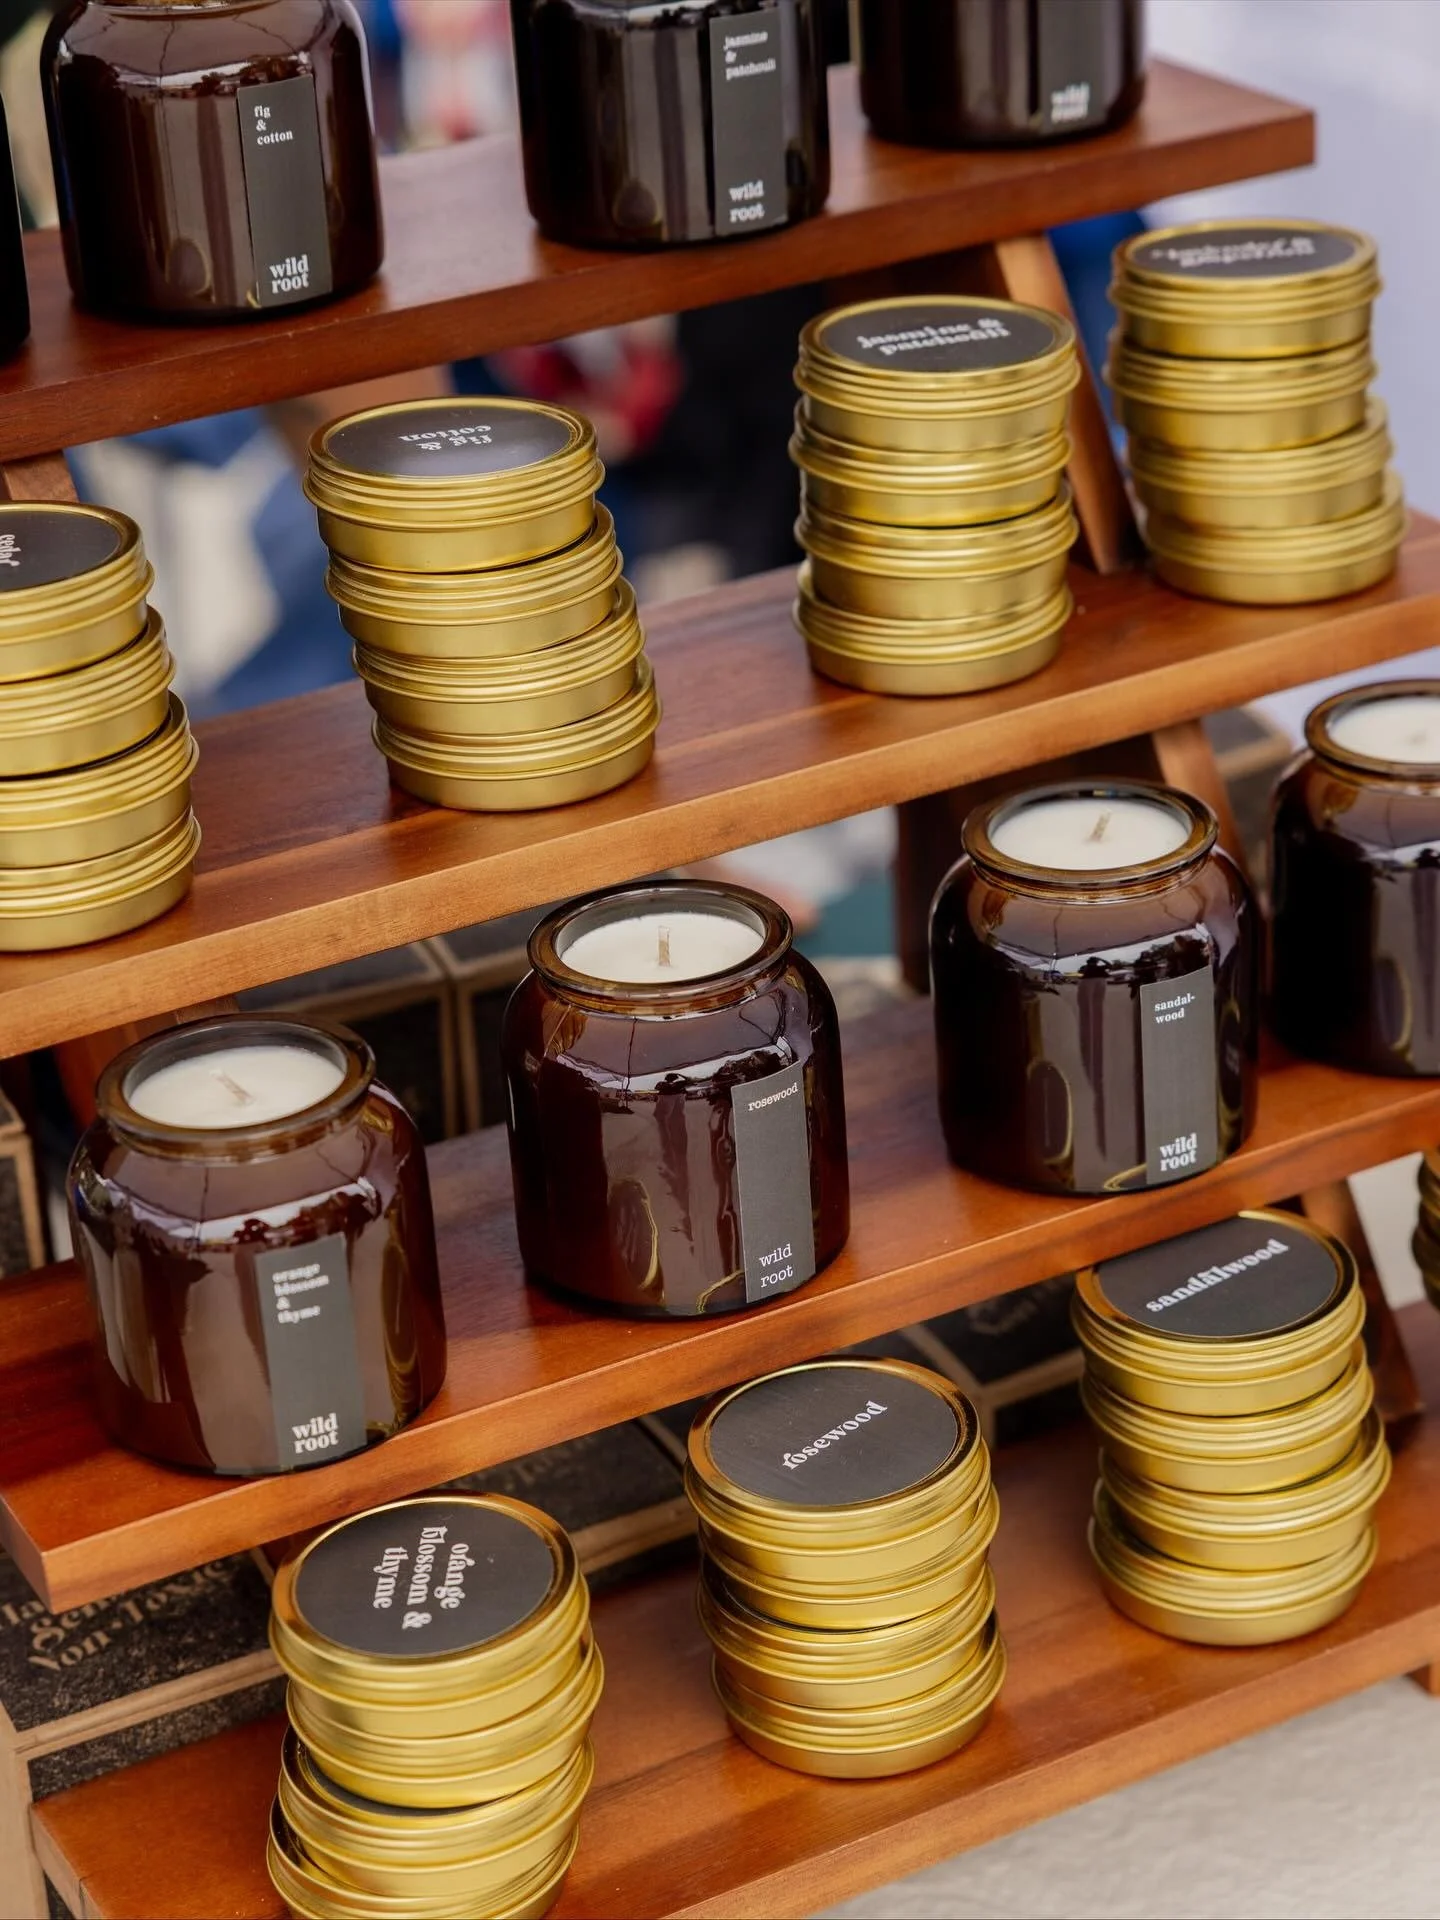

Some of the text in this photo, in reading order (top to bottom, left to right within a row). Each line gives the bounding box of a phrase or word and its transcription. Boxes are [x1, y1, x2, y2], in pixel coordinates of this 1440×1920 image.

[254, 105, 271, 118] fig
[255, 119, 267, 132] &
[257, 130, 293, 145] cotton
[729, 180, 764, 202] wild
[730, 203, 765, 223] root
[269, 254, 309, 280] wild
[271, 272, 309, 293] root
[399, 425, 492, 442] cotton
[448, 434, 493, 447] fig
[1154, 993, 1195, 1012] sandal-
[1155, 1007, 1185, 1024] wood
[748, 1082, 798, 1111] rosewood
[1160, 1132, 1198, 1158] wild
[1159, 1149, 1197, 1172] root
[759, 1243, 793, 1267] wild
[760, 1264, 793, 1288] root
[1146, 1238, 1291, 1312] sandalwood
[292, 1412, 338, 1439] wild
[782, 1400, 888, 1470] rosewood
[294, 1431, 339, 1454] root
[373, 1547, 409, 1609] thyme
[402, 1526, 448, 1630] blossom &
[434, 1543, 476, 1610] orange
